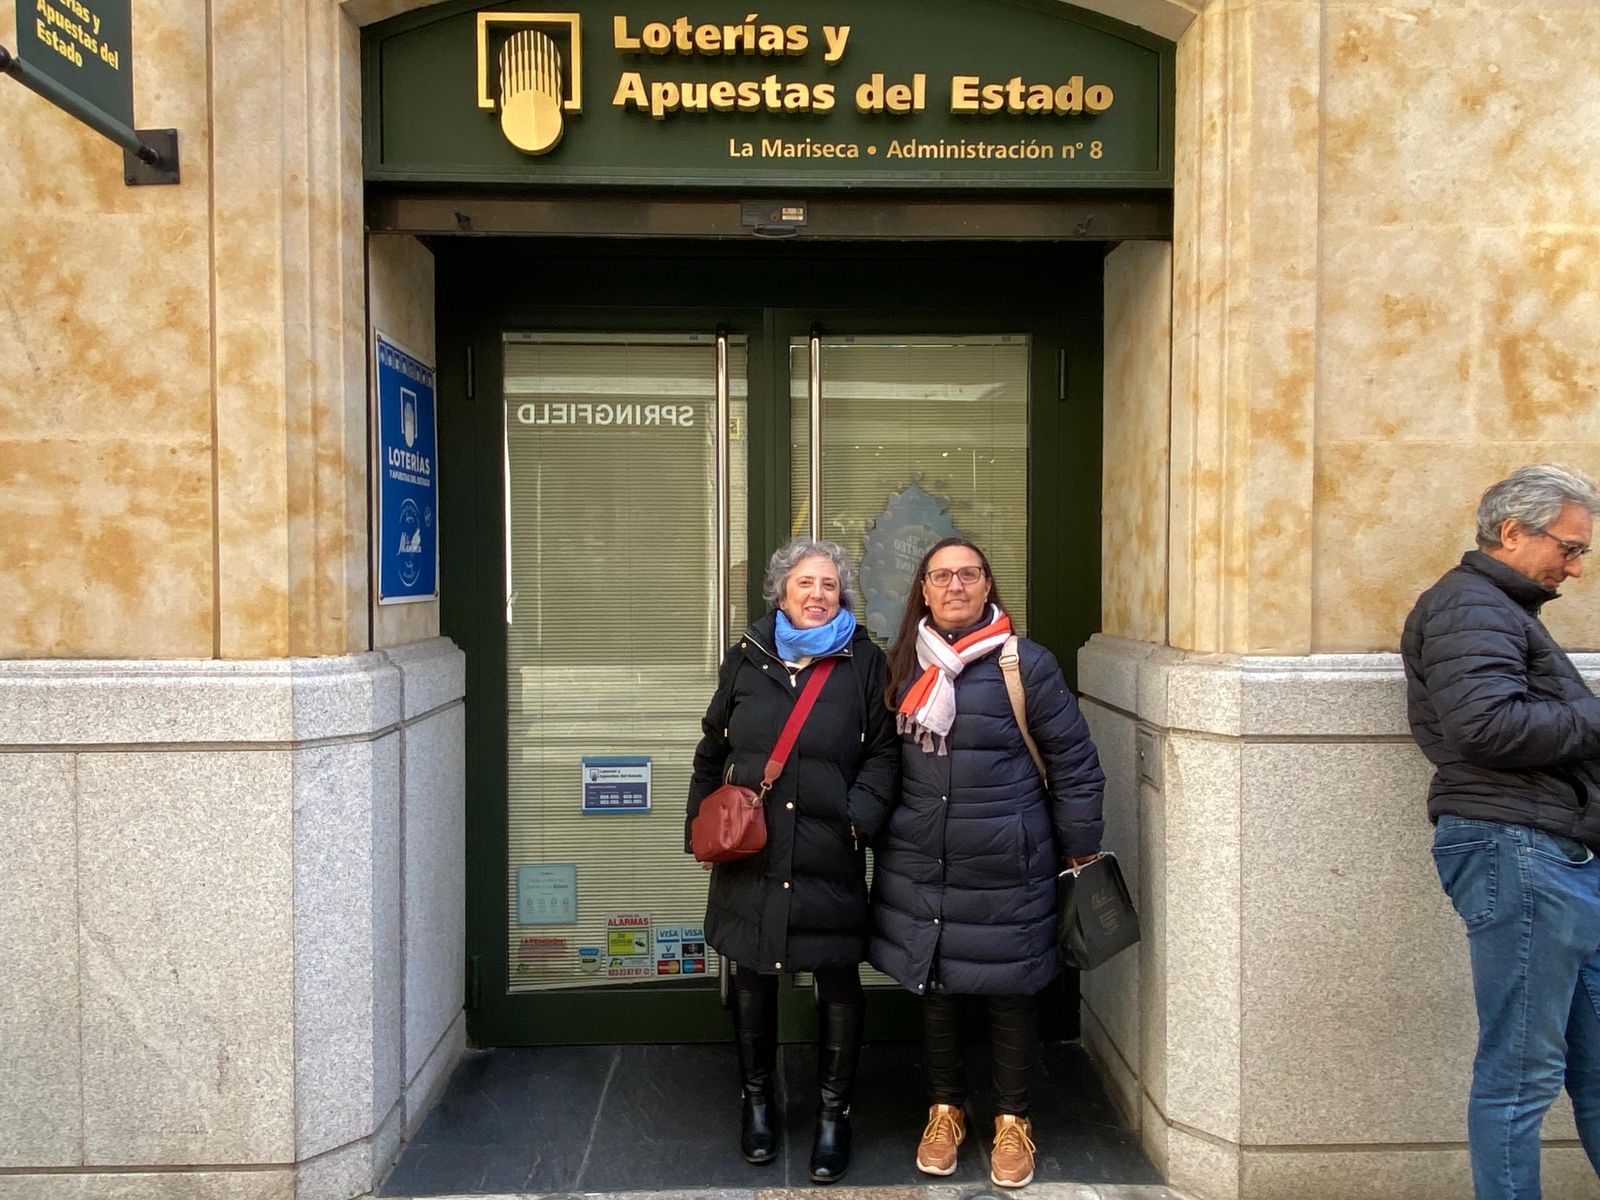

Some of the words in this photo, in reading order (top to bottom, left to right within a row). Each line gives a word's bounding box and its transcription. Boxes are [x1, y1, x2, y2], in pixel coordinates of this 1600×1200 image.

[37, 0, 97, 54] Apuestas
[100, 42, 118, 70] del
[93, 14, 100, 35] y
[613, 13, 809, 54] Loterías
[822, 26, 850, 63] y
[37, 18, 82, 67] Estado
[612, 72, 835, 118] Apuestas
[855, 73, 926, 113] del
[950, 76, 1114, 114] Estado
[729, 139, 754, 157] La
[761, 138, 859, 158] Mariseca
[886, 138, 1053, 159] Administración
[1089, 141, 1103, 159] 8
[388, 446, 430, 475] LOTERÍAS
[608, 918, 649, 926] ALARMAS
[660, 929, 678, 938] VISA
[684, 929, 703, 937] VISA
